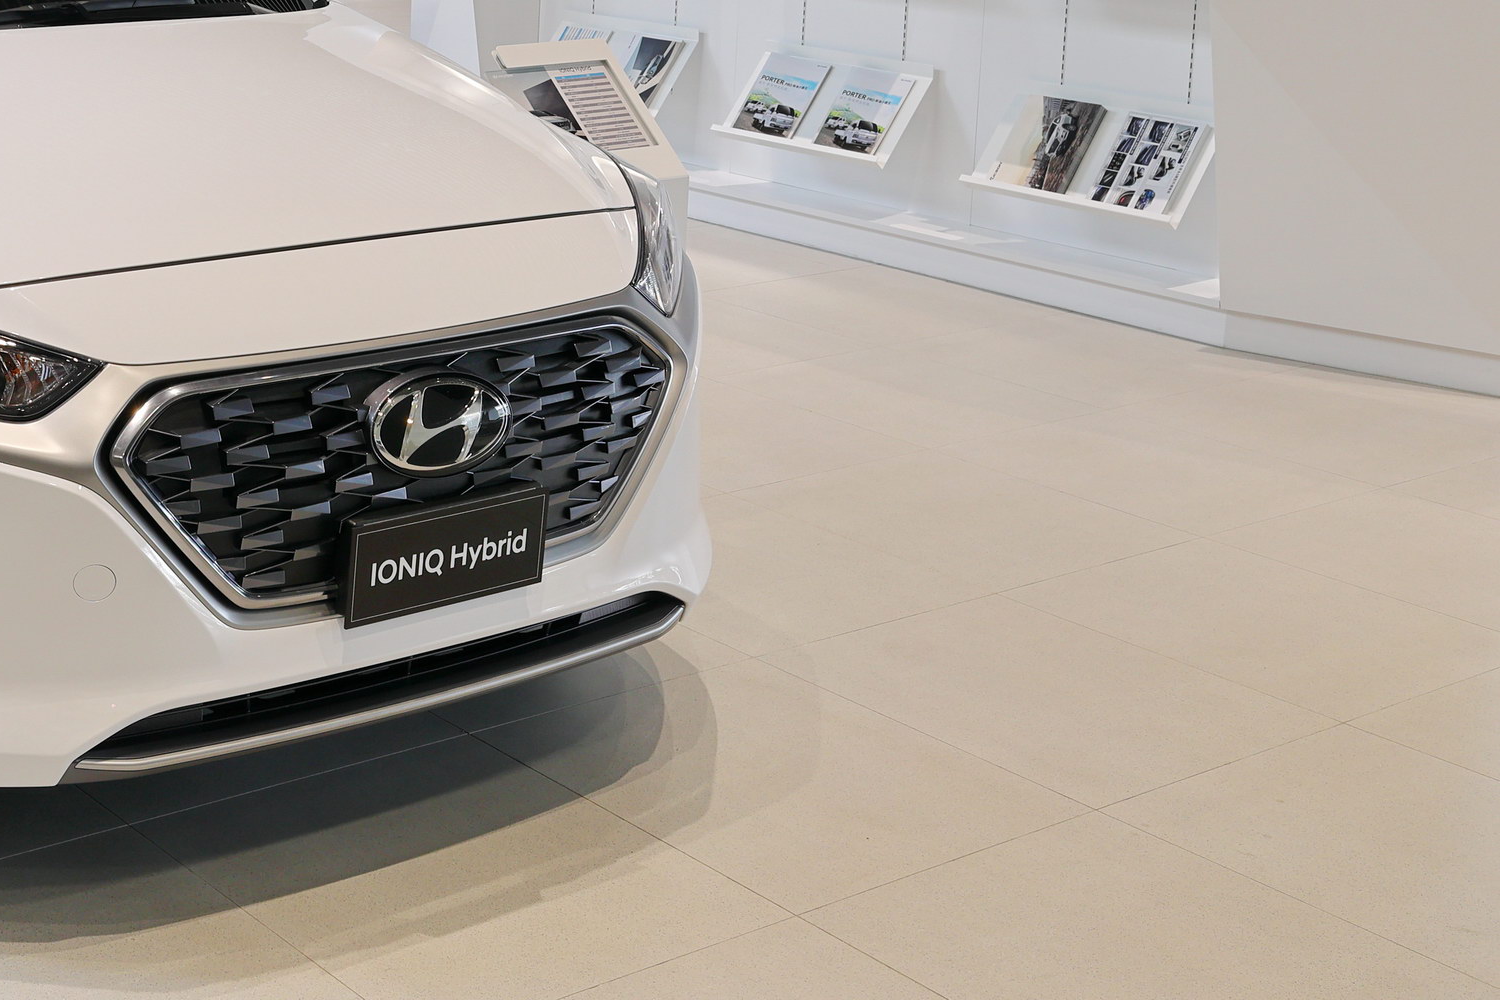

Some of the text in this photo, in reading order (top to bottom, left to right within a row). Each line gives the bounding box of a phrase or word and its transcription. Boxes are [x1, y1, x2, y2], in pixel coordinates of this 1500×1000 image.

[761, 74, 785, 86] PORTER
[842, 89, 867, 100] PORTER
[370, 527, 528, 587] IONIQ Hybrid
